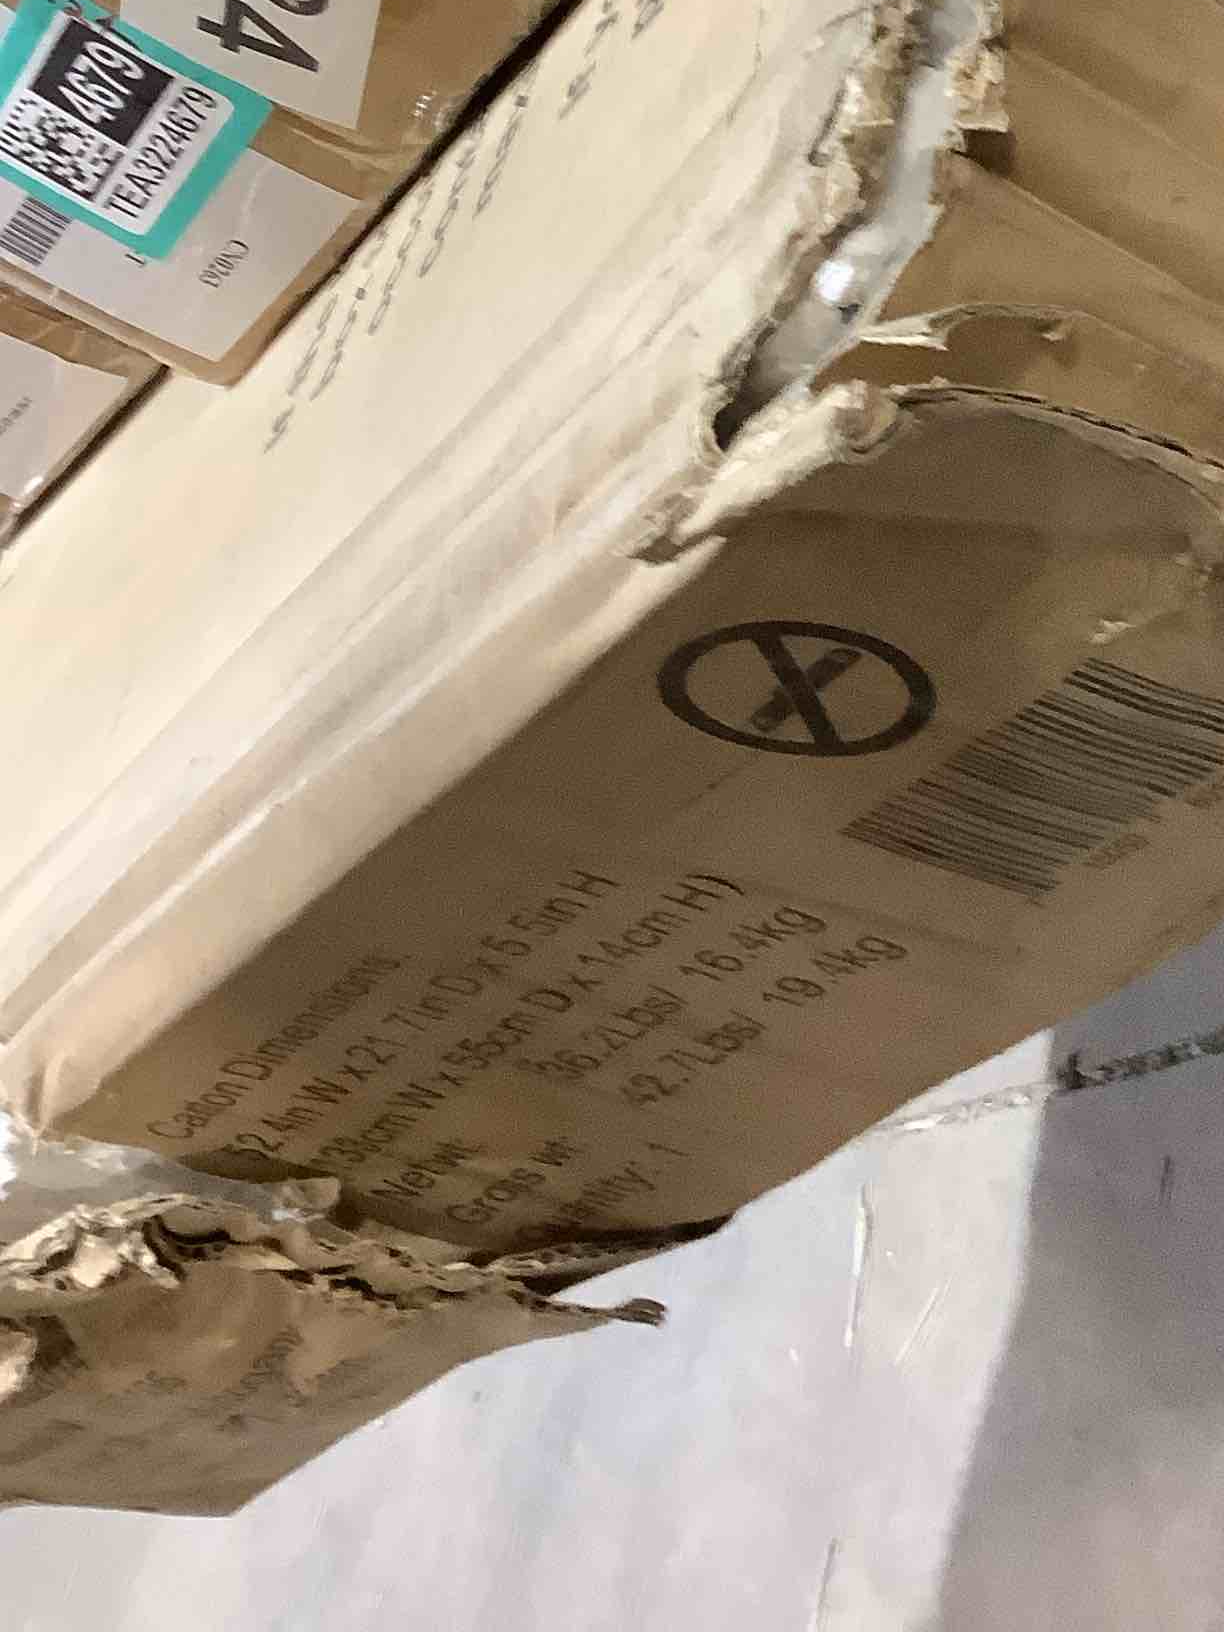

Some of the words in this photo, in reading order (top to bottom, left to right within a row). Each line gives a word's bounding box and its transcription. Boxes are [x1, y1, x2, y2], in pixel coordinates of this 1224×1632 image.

[57, 40, 146, 125] 4679
[102, 84, 219, 219] TEA3224679
[556, 867, 622, 899] H
[516, 987, 577, 1014] D
[659, 872, 746, 914] H)
[678, 905, 829, 984] 16.4kg
[762, 935, 908, 1009] 19.4kg
